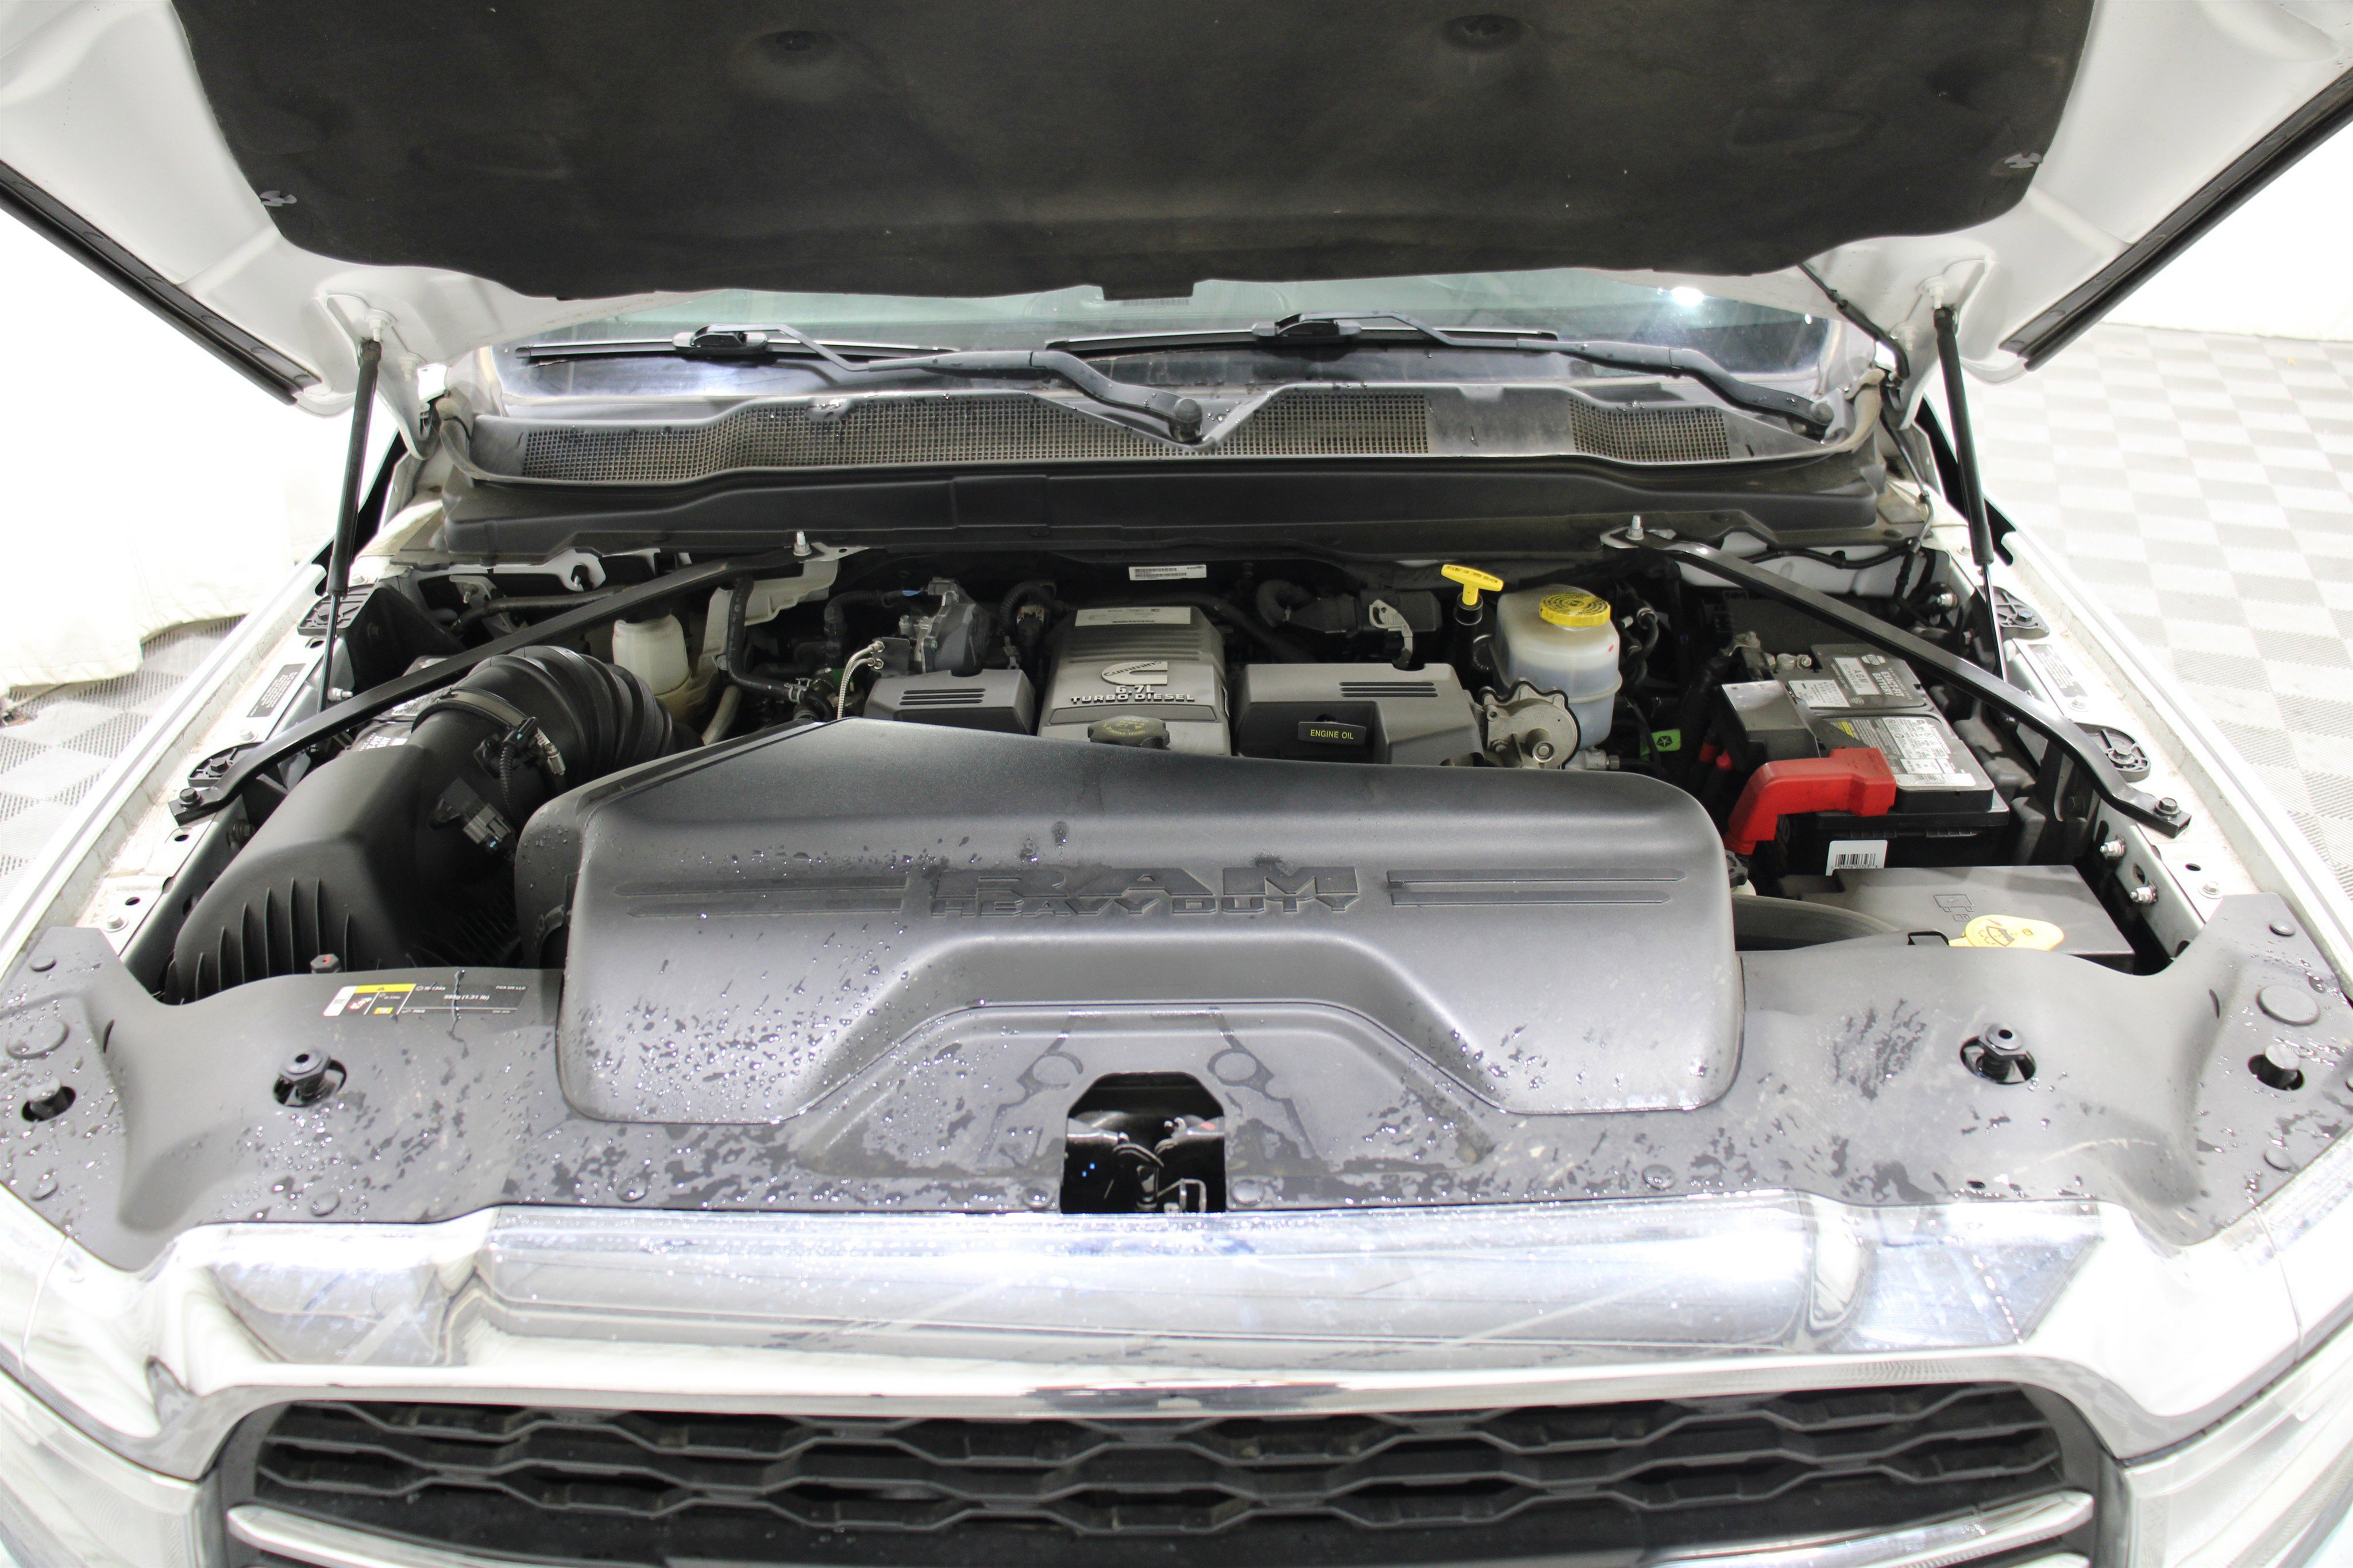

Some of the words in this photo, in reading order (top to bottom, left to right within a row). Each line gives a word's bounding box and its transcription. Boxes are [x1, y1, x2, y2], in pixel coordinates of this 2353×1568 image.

[1853, 670, 1868, 684] AGM
[1872, 673, 1894, 696] BATTERY
[1880, 671, 1905, 697] EXACT-FIT
[1071, 694, 1129, 704] TURBO
[1135, 693, 1195, 702] DIESEL
[1116, 685, 1155, 694] 6.7L
[1310, 729, 1339, 739] ENGINE
[935, 866, 1359, 898] RAM
[931, 897, 1160, 918] HEAVY
[1172, 895, 1360, 914] DUTY
